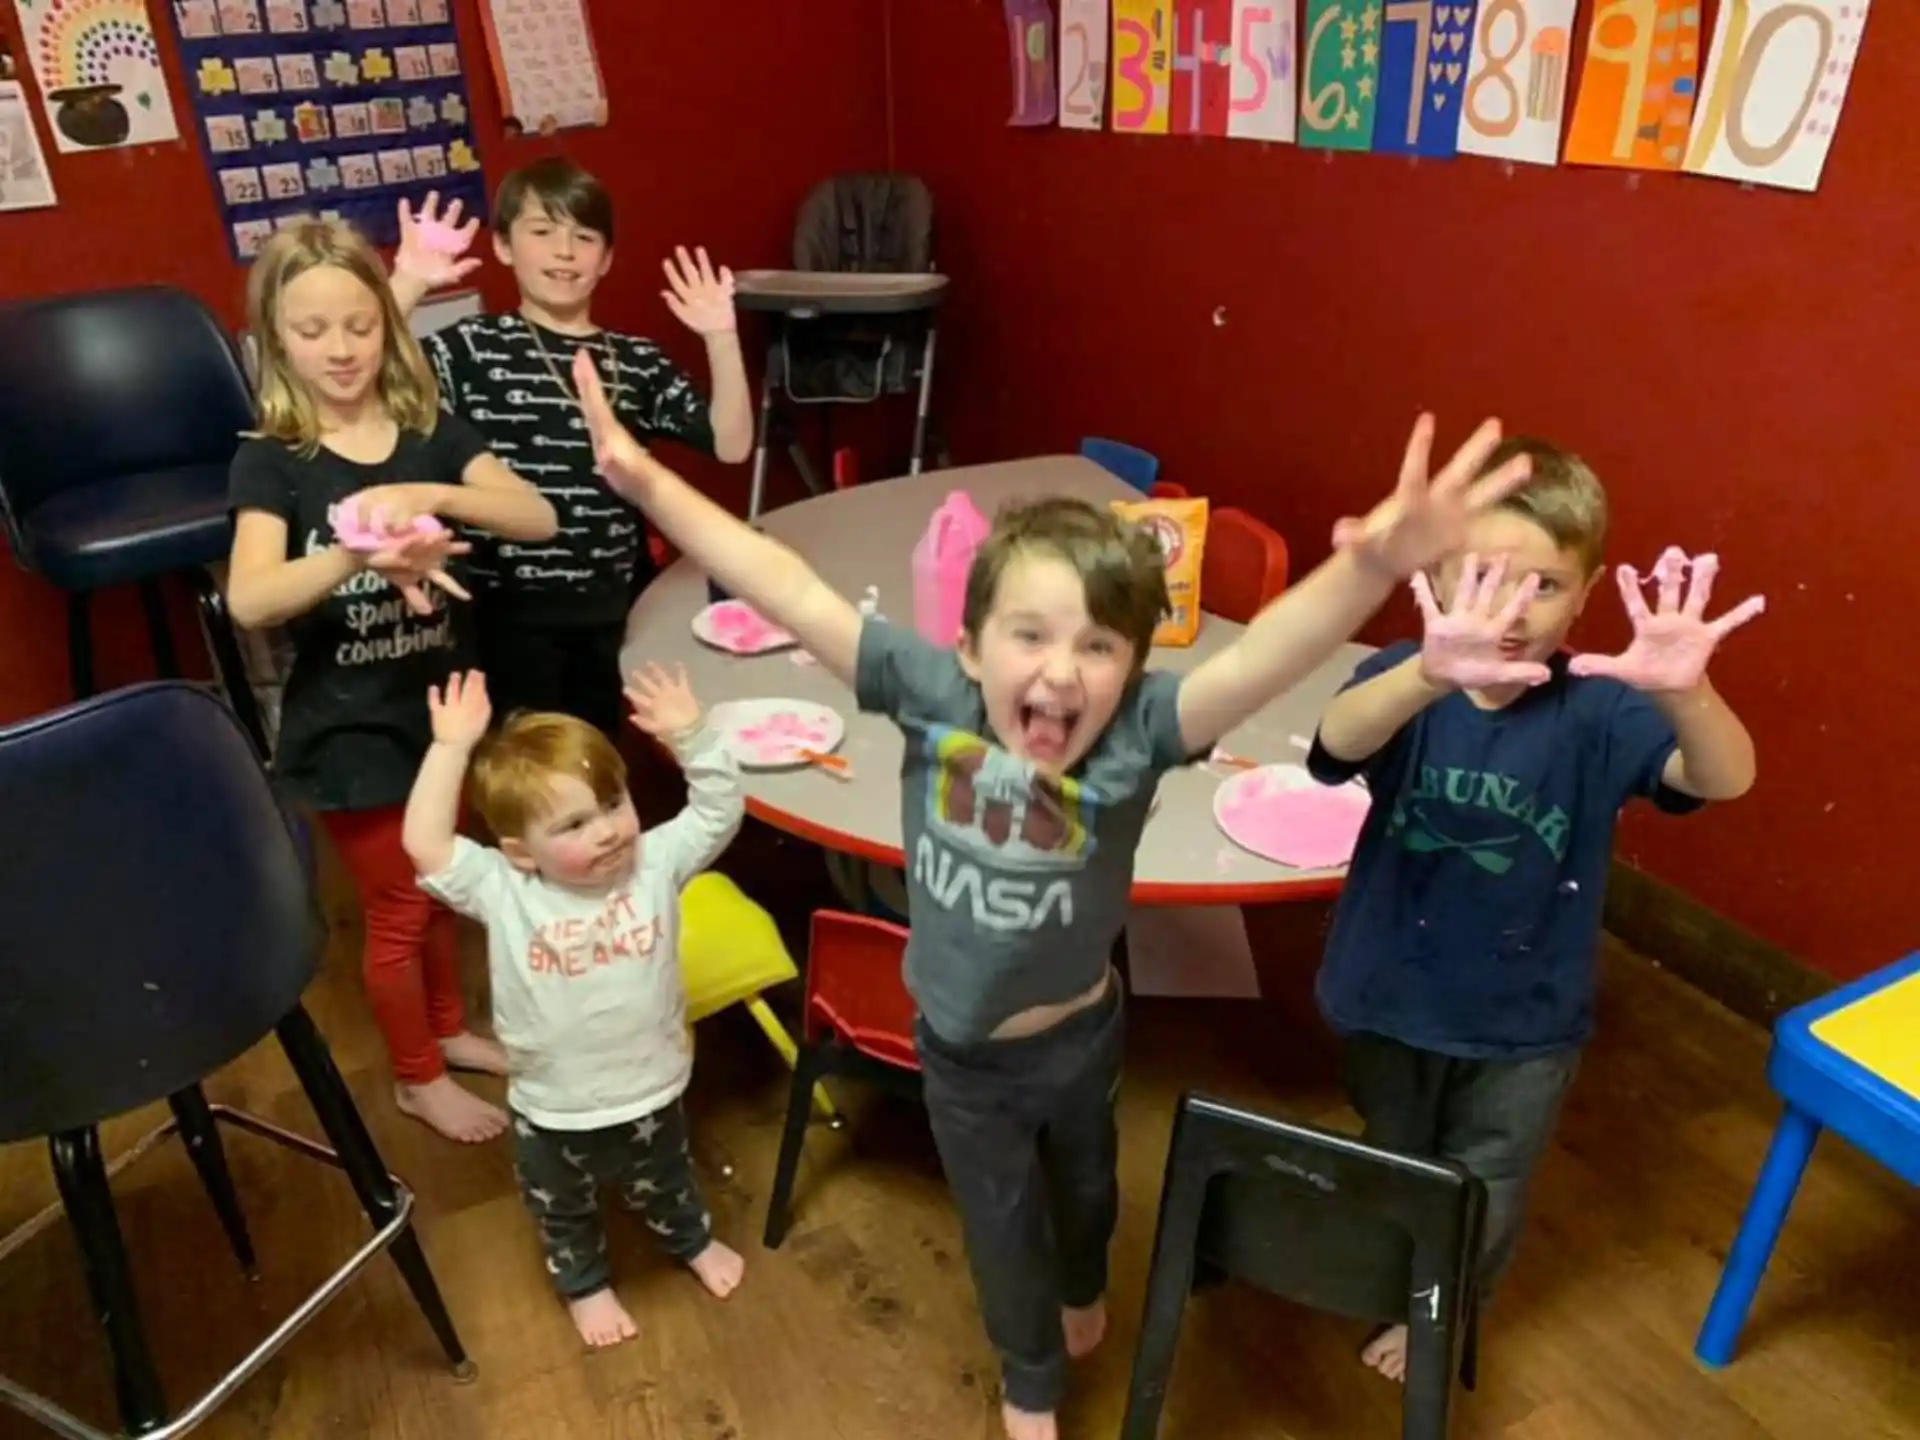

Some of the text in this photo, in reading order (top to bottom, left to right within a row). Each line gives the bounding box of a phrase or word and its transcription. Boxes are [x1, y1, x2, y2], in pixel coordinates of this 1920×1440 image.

[246, 12, 260, 30] 2
[293, 12, 305, 29] 3
[296, 68, 315, 85] 10
[1064, 22, 1094, 114] 2
[1116, 18, 1154, 128] 3
[1173, 8, 1204, 132] 4
[1230, 7, 1273, 114] 5
[1301, 4, 1345, 130] 6
[1386, 0, 1432, 144] 7
[1464, 0, 1527, 138] 8
[1588, 0, 1658, 159] 9
[1680, 0, 1833, 168] 10
[225, 128, 246, 149] 15
[235, 182, 258, 199] 22
[279, 176, 300, 194] 23
[914, 832, 1074, 931] NASA
